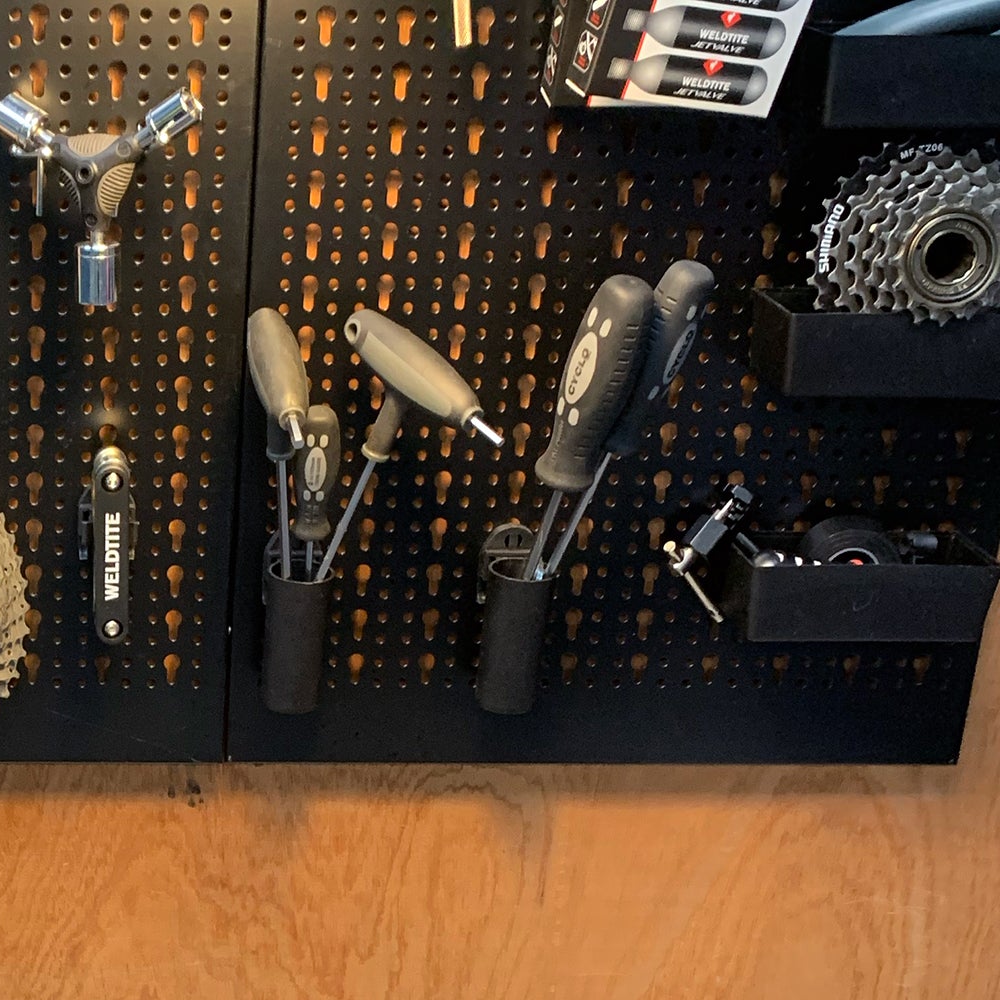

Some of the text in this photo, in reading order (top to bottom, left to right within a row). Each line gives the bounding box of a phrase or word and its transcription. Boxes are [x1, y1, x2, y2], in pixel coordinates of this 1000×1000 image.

[690, 41, 746, 55] JETVALVE
[699, 28, 750, 44] WELDTITE
[673, 87, 727, 101] JETVALVE
[682, 76, 732, 92] WELDTITE
[818, 203, 845, 274] SHIMANO
[667, 329, 695, 378] CYCLO
[568, 347, 593, 396] CYCLO
[104, 511, 121, 602] WELDTITE
